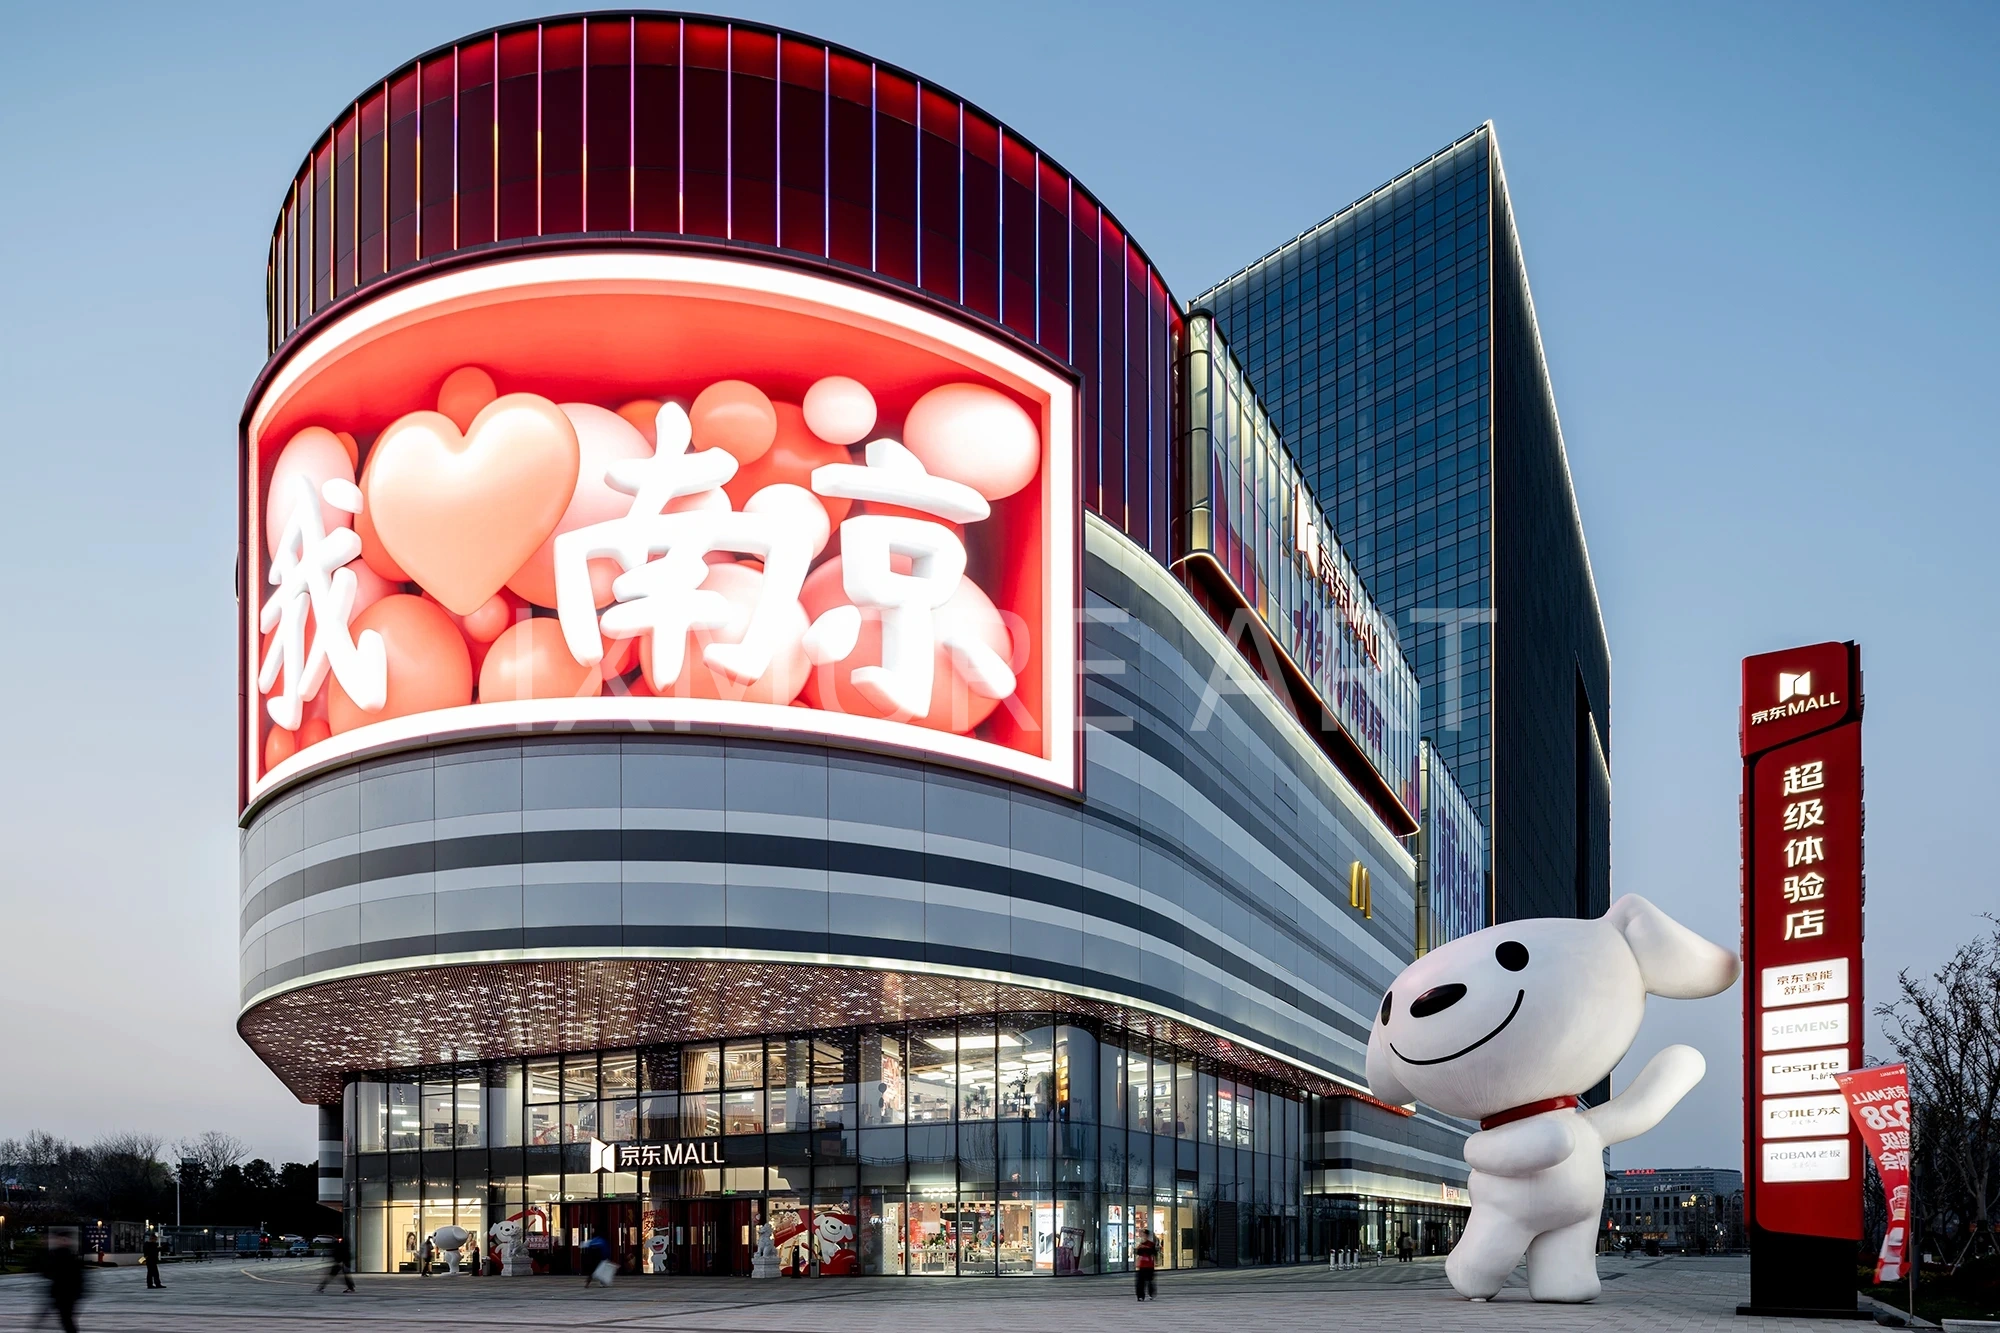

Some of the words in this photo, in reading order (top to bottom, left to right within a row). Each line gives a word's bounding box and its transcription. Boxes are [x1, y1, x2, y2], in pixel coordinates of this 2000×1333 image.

[258, 474, 388, 731] 我
[554, 401, 1018, 719] 南京
[1318, 542, 1383, 673] 京东MALL
[1751, 692, 1841, 725] 京东MALL
[1783, 760, 1825, 941] 超级体验店
[1776, 969, 1833, 985] 京东智能
[1771, 1019, 1839, 1036] SIEMENS
[1771, 1061, 1839, 1074] Casarte
[1770, 1108, 1815, 1119] FOTILE
[1817, 1106, 1841, 1116] 方太
[620, 1141, 726, 1167] 京东MALL
[1770, 1151, 1817, 1161] ROBAM
[1819, 1149, 1841, 1159] 老板
